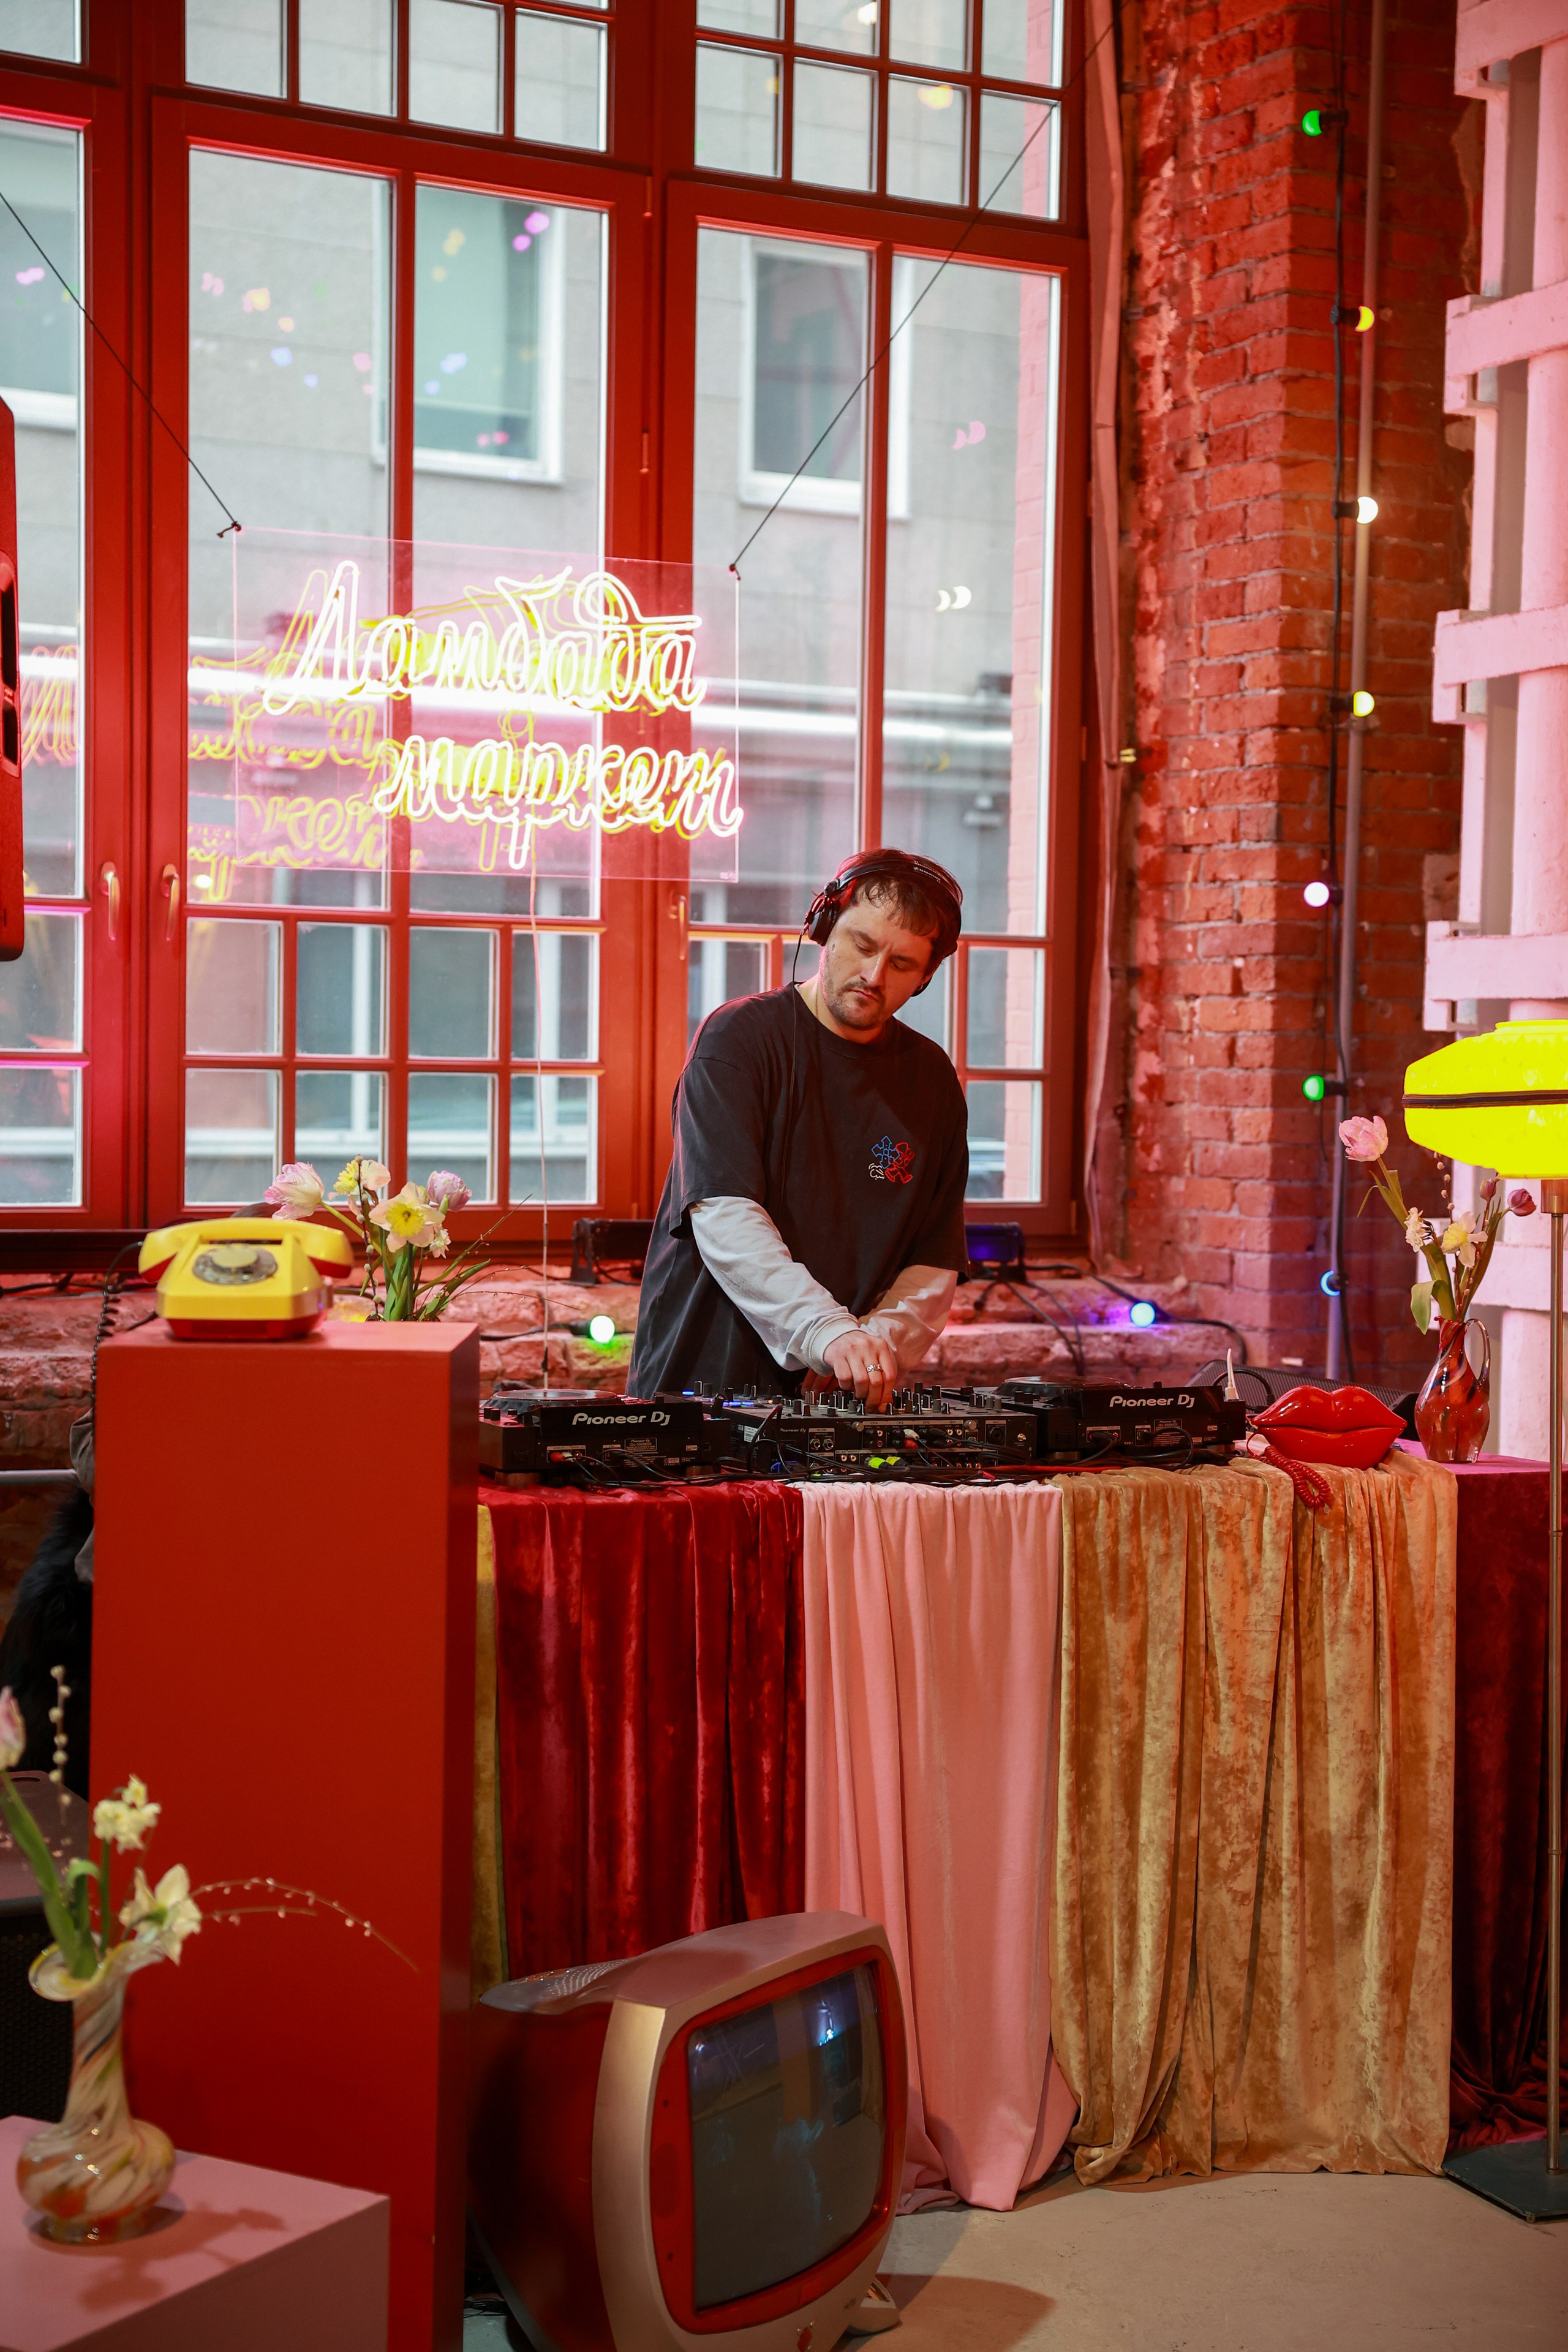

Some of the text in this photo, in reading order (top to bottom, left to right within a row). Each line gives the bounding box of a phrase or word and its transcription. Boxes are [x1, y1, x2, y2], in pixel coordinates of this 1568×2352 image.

[262, 560, 707, 715] Ламбада
[374, 734, 743, 869] маркет
[571, 1412, 647, 1425] Pioneer
[1109, 1395, 1174, 1408] Pioneer
